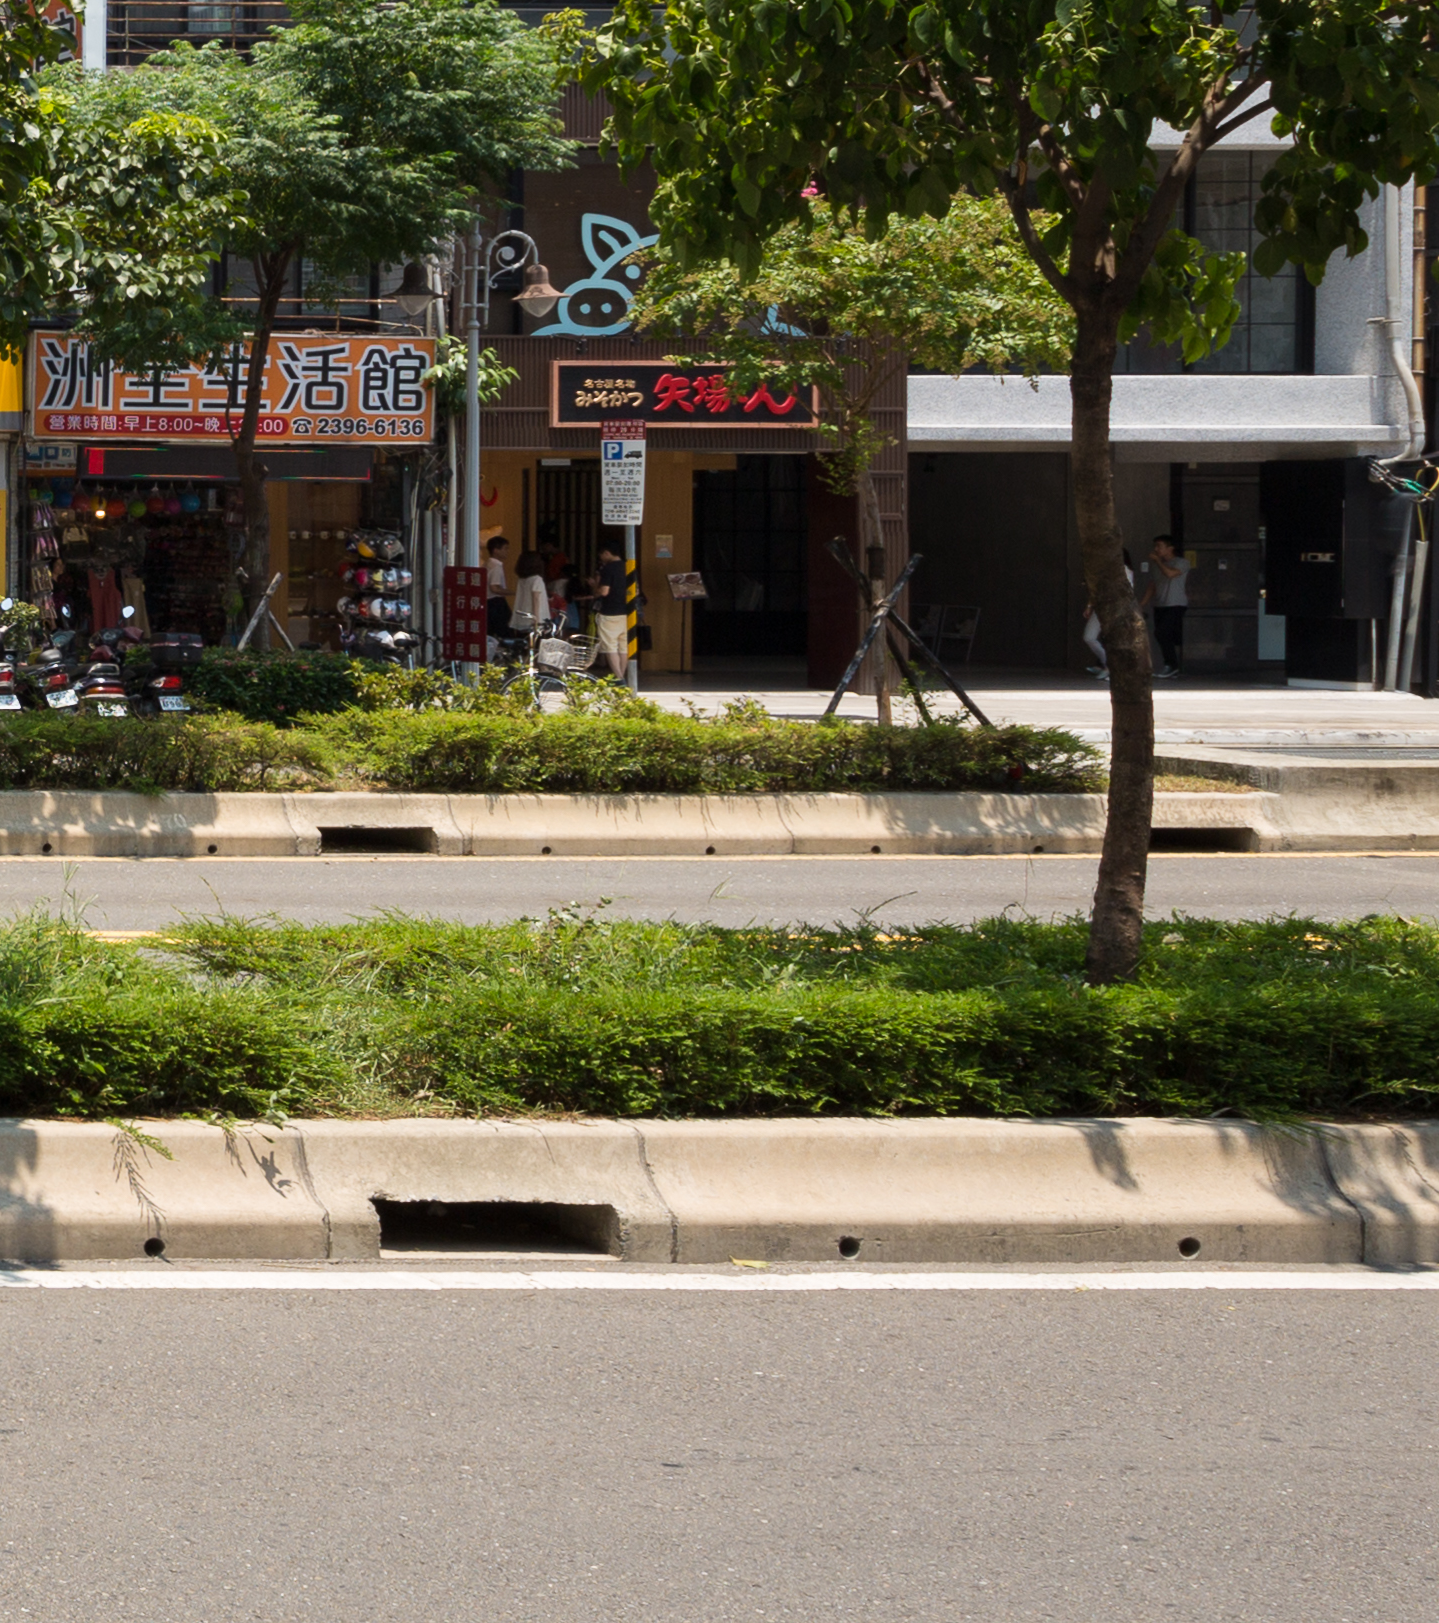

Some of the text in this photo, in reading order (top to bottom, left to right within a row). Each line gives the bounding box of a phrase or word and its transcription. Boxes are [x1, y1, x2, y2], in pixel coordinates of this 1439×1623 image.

[574, 390, 645, 408] みそかつ
[652, 373, 799, 415] 矢場ん
[316, 417, 425, 436] 2396-6136
[606, 443, 620, 459] P
